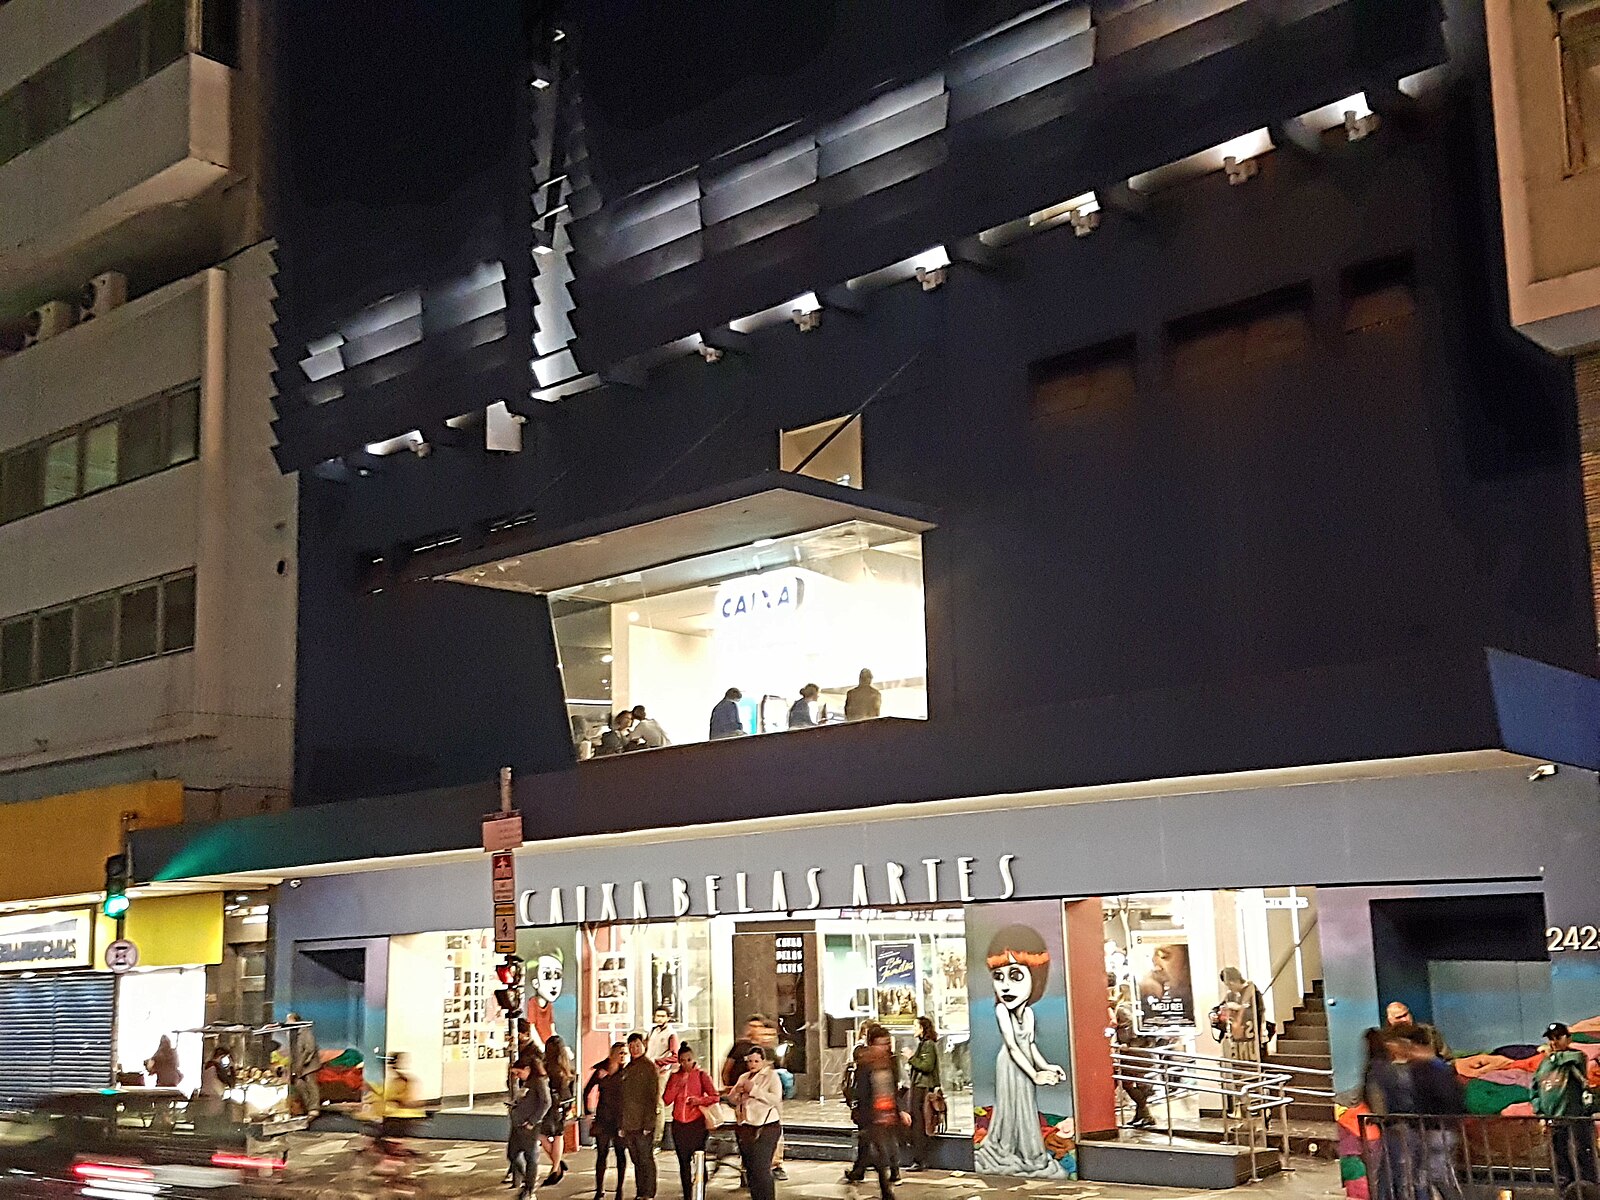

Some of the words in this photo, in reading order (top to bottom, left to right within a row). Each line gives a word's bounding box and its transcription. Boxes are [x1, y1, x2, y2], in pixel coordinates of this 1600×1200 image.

[519, 880, 649, 926] CAIXA
[672, 867, 822, 918] BELAS
[852, 854, 1015, 907] ARTES
[1545, 925, 1600, 951] 242
[1151, 1003, 1170, 1011] MEU
